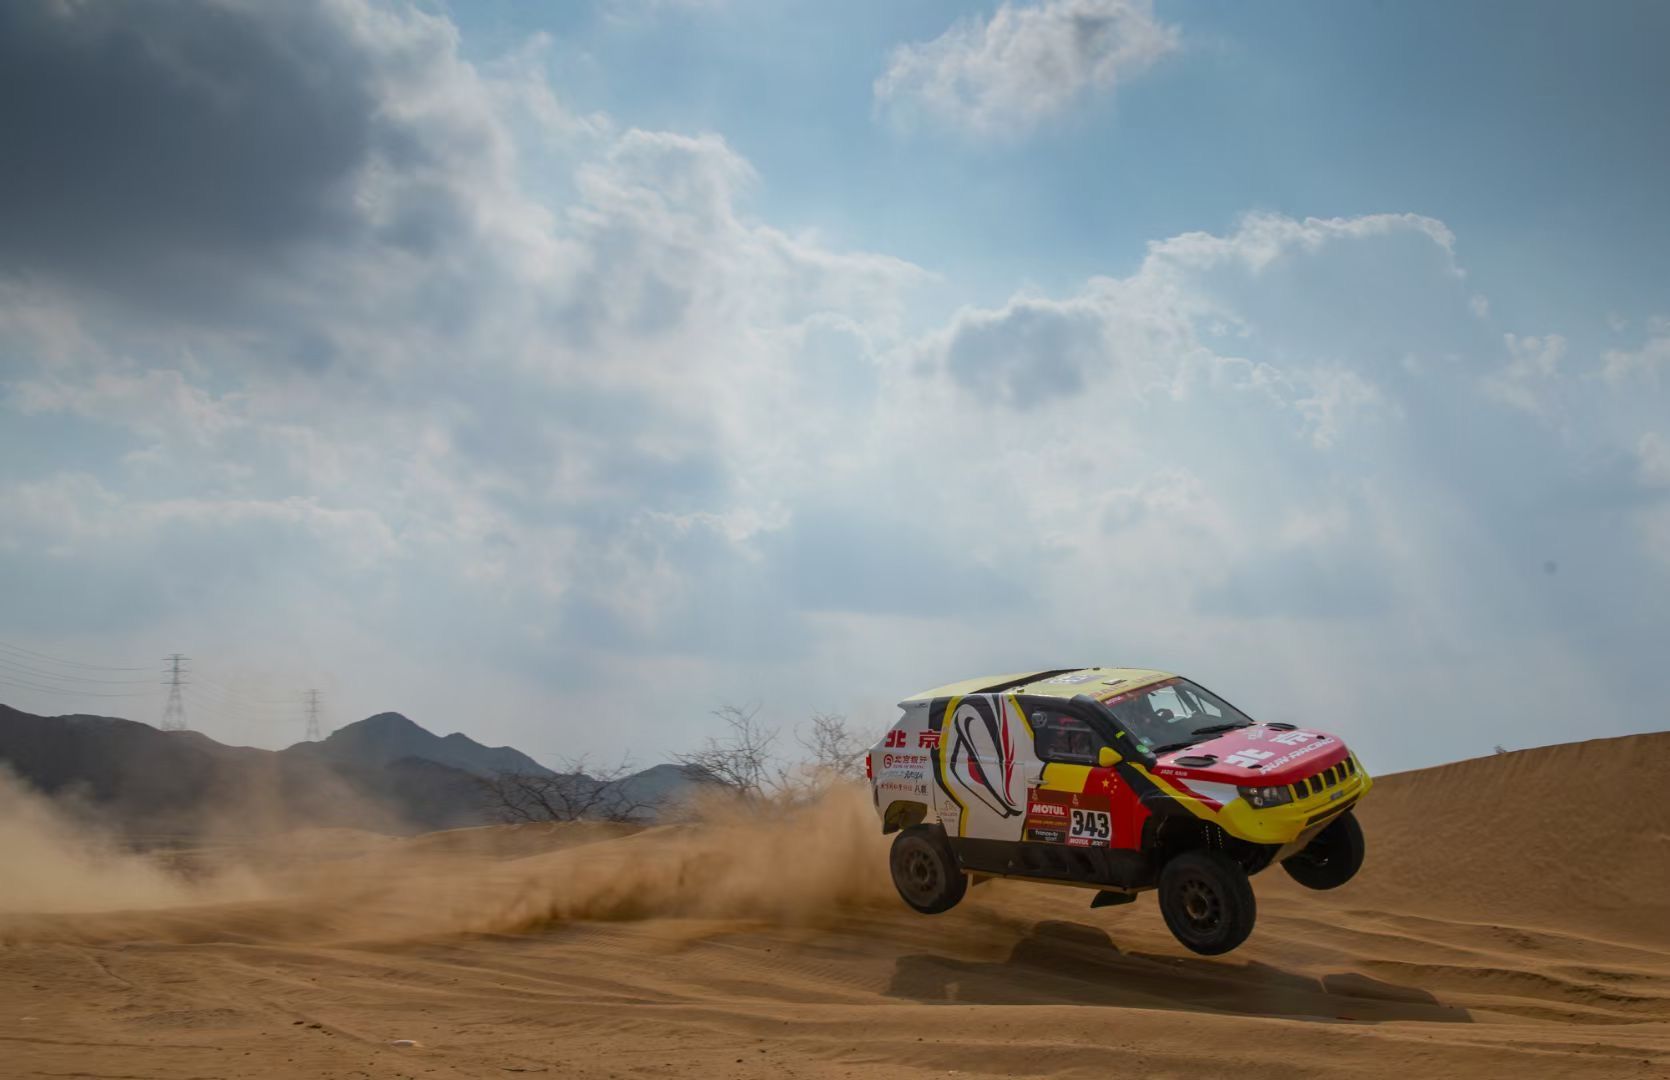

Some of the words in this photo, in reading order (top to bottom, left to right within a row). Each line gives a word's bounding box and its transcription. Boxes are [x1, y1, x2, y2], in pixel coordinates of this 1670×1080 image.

[884, 729, 941, 748] 北京
[1031, 803, 1065, 815] MOTUL
[1072, 810, 1109, 839] 343
[1069, 837, 1089, 846] MOTUL
